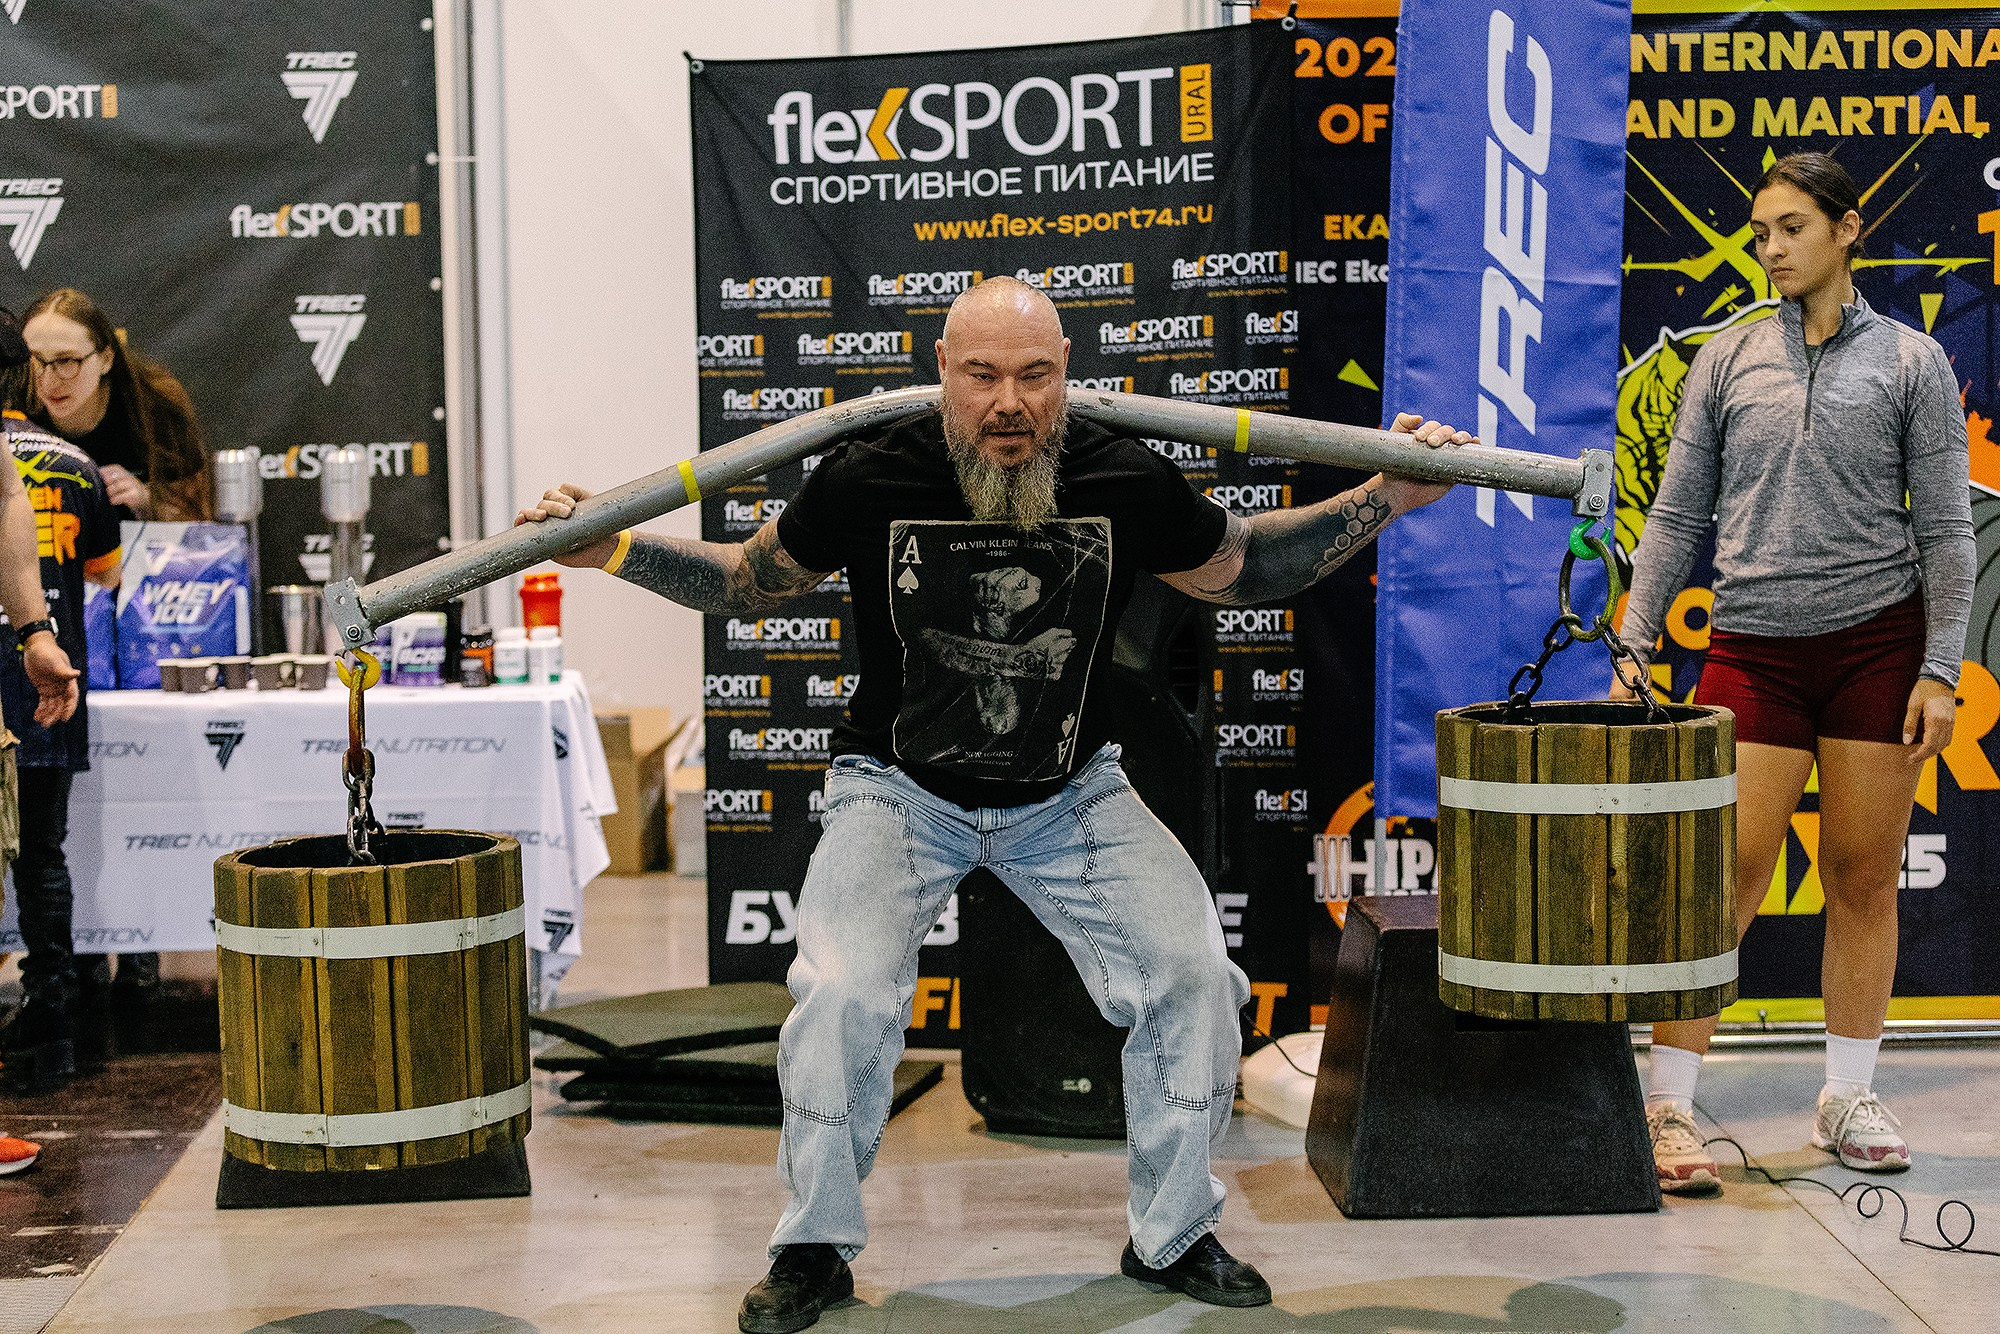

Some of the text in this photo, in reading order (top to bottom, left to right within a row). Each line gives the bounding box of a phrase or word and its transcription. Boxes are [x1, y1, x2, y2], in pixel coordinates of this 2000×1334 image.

[285, 51, 359, 69] TREC
[1186, 69, 1208, 138] URAL
[1625, 94, 1991, 139] AND MARTIAL
[1318, 103, 1390, 144] OF
[769, 152, 1216, 206] СПОРТИВНОЕ ПИТАНИЕ
[913, 203, 1214, 241] www.flex-sport74.ru
[898, 535, 923, 565] A
[949, 540, 987, 552] CALVIN
[988, 539, 1019, 548] KLEIN
